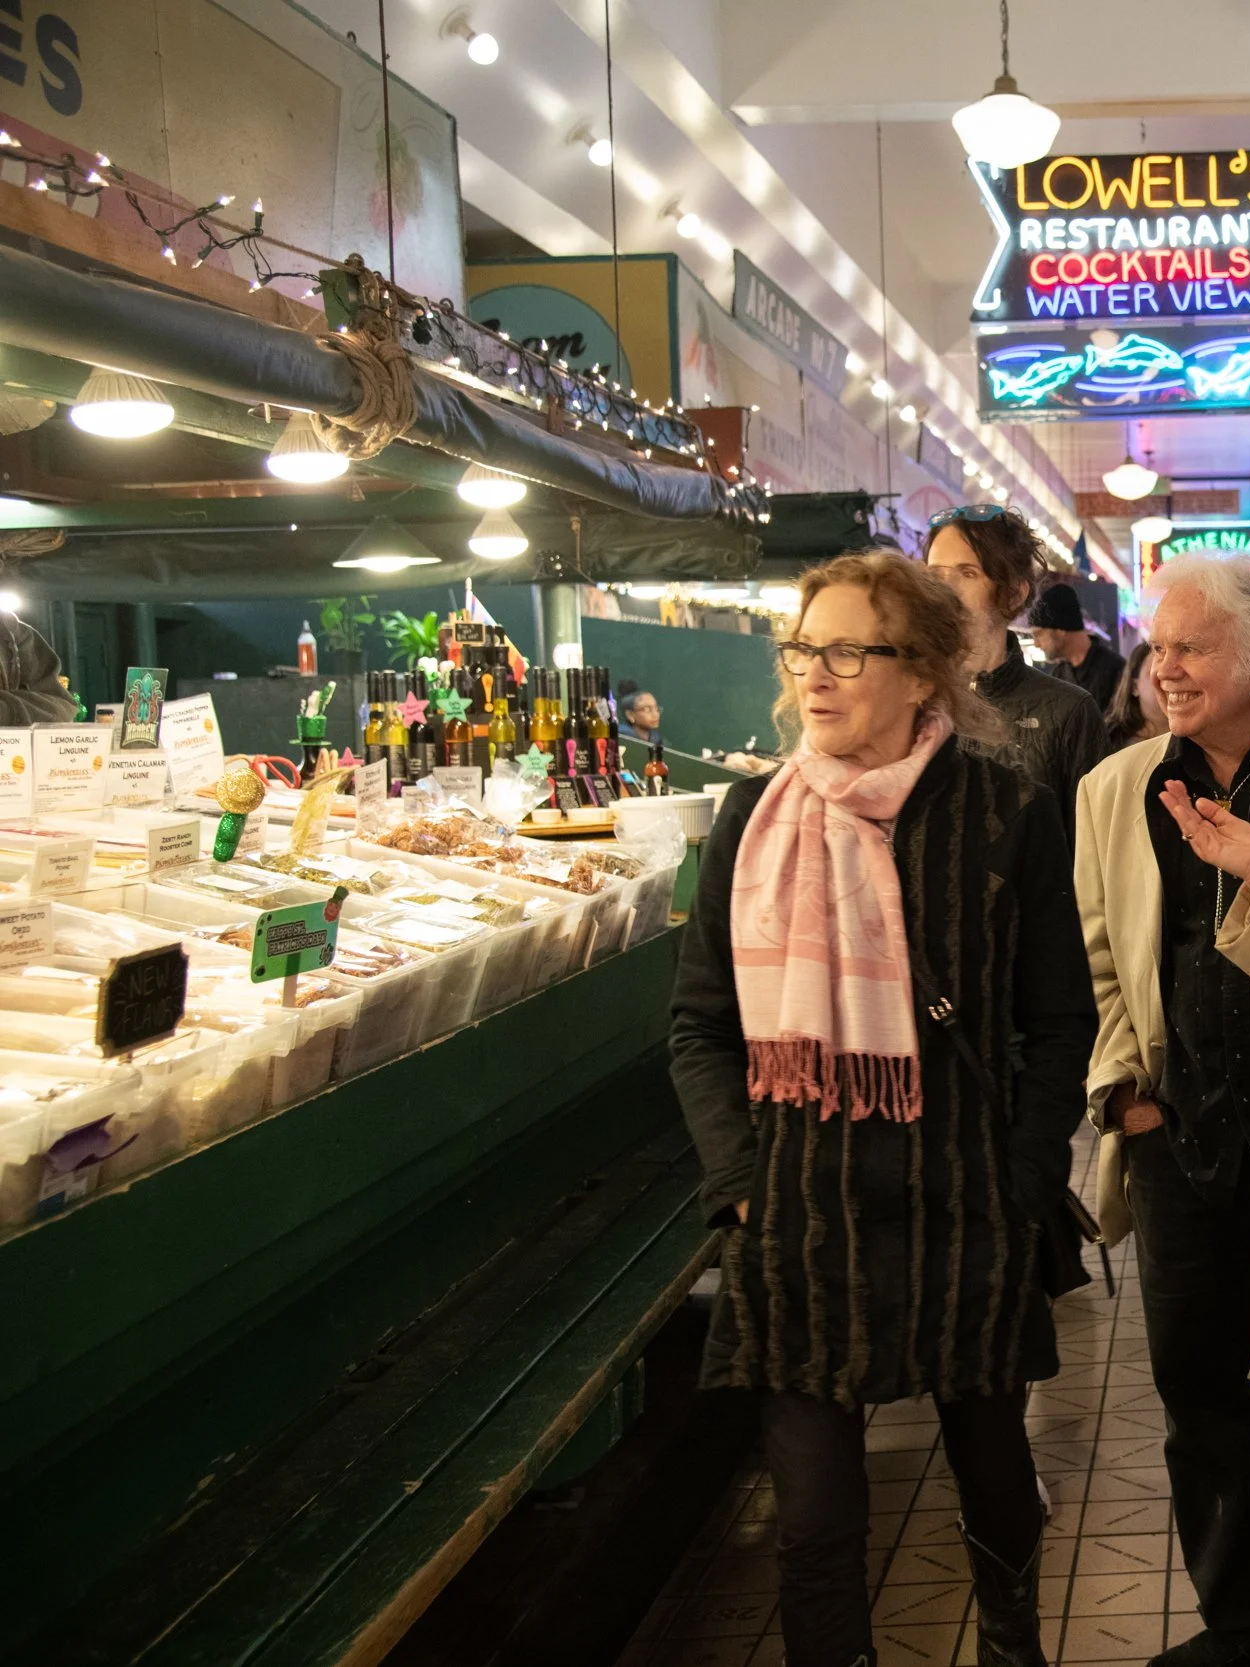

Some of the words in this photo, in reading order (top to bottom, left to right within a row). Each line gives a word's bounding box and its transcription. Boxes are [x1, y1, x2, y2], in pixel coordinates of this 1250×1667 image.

[1026, 283, 1159, 317] WATER
[745, 274, 801, 353] ARCADE
[51, 736, 74, 744] LEMON
[75, 736, 98, 744] GARLIC
[59, 747, 89, 755] LINGUINE
[108, 761, 137, 769] VENETIAN
[138, 759, 166, 768] CALAMARI
[123, 772, 150, 780] LINGUINE
[0, 915, 20, 924] WEET
[21, 911, 45, 921] POTATO
[129, 959, 170, 999] NEW
